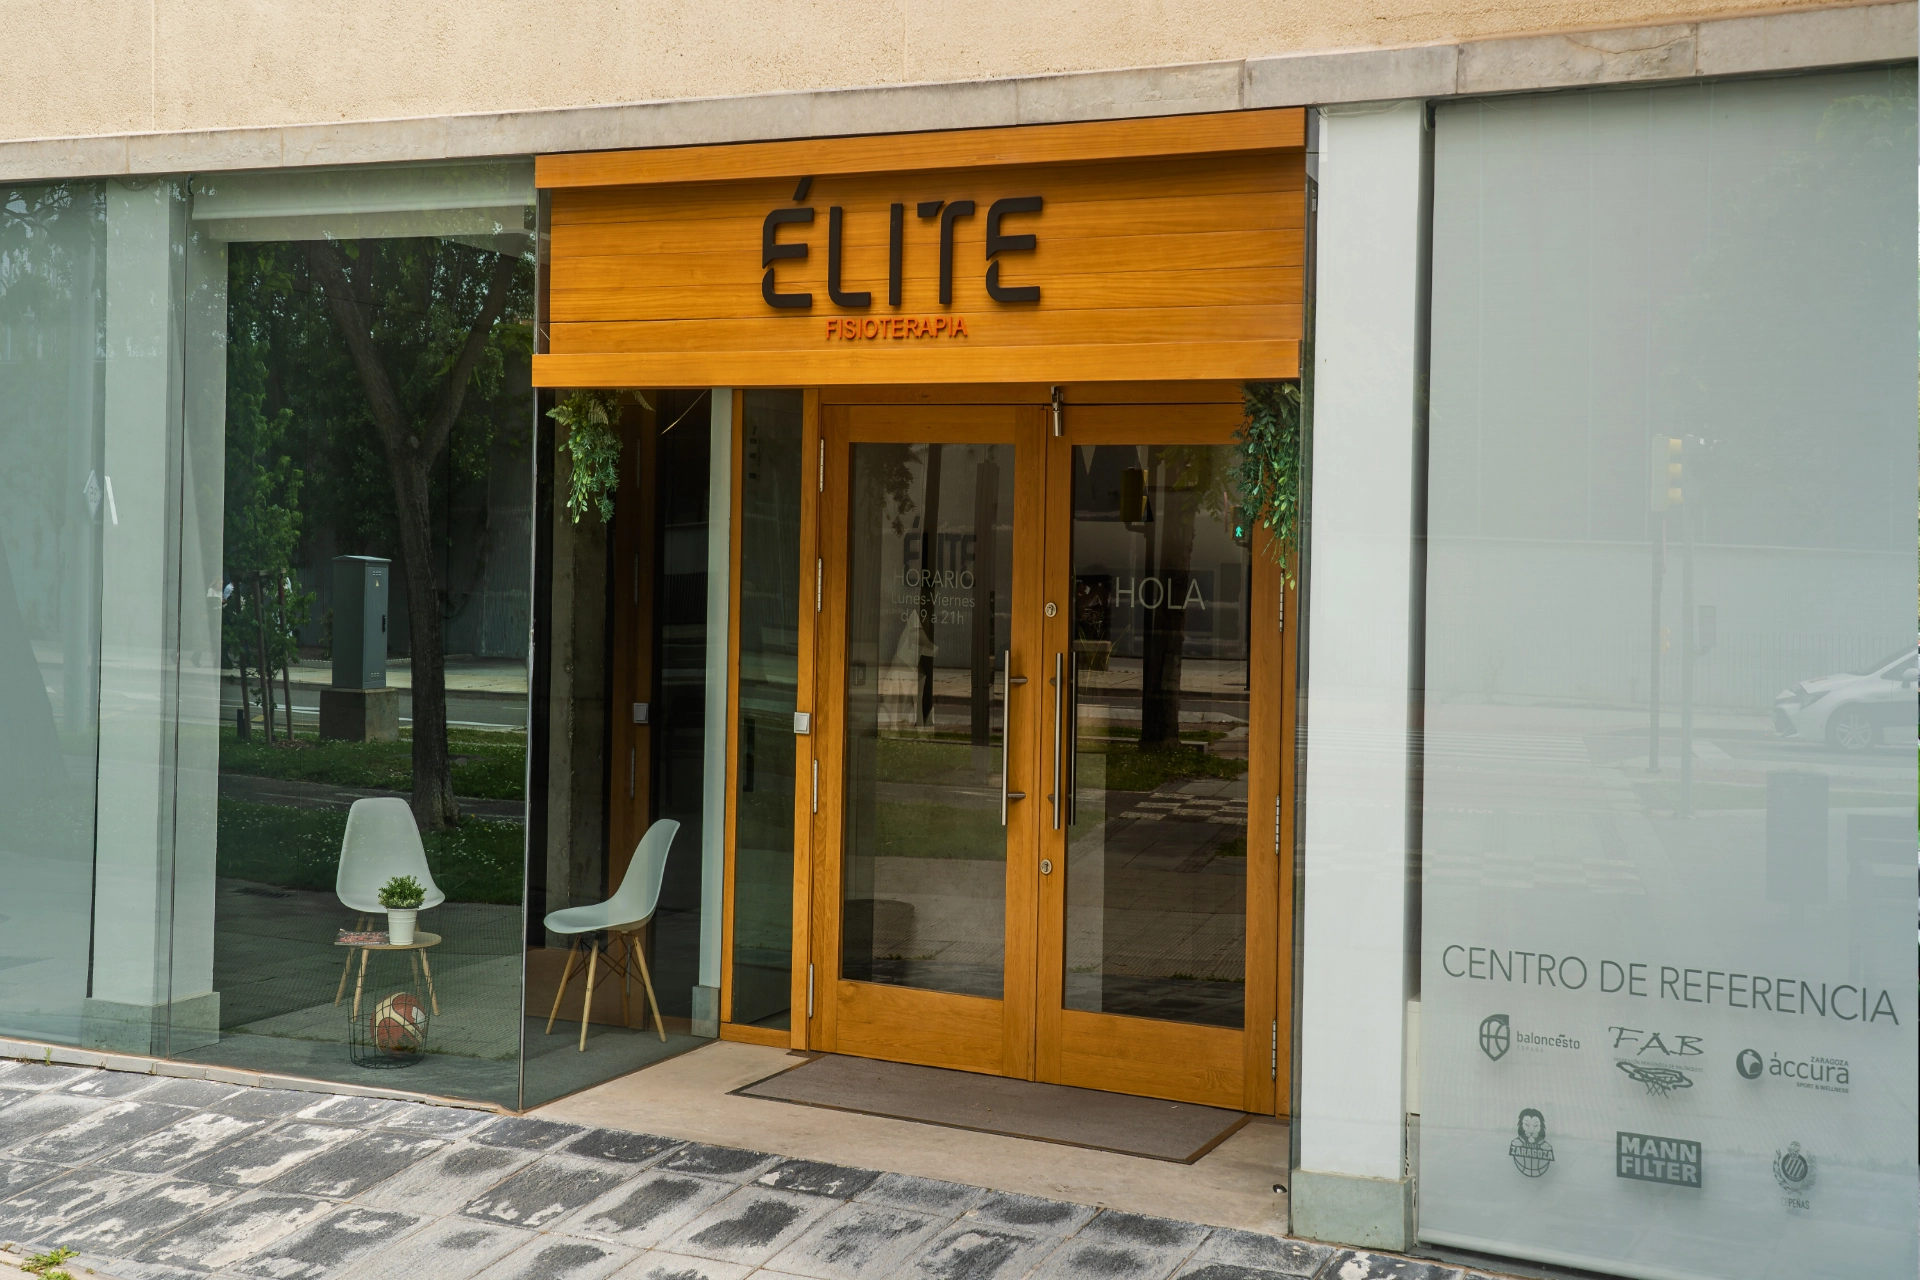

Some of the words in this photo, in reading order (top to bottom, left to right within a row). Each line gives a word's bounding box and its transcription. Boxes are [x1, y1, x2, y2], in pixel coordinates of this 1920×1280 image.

[762, 176, 1043, 308] ÉLITE
[826, 316, 968, 340] FISIOTERAPIA
[893, 568, 975, 590] HORARIO
[891, 591, 976, 608] Lunes-Viernes
[1115, 576, 1206, 611] HOLA
[920, 608, 928, 623] 9
[931, 613, 938, 623] a
[941, 610, 964, 625] 21h
[1442, 944, 1588, 990] CENTRO
[1600, 959, 1648, 997] DE
[1660, 966, 1900, 1026] REFERENCIA
[1608, 1026, 1704, 1056] FAB
[1810, 1056, 1850, 1068] ZARAGOZA
[1796, 1081, 1814, 1090] SPORT
[1820, 1084, 1850, 1094] WELLNESS
[1510, 1146, 1553, 1160] ZARAGOZA
[1621, 1135, 1698, 1163] MANN
[1621, 1155, 1698, 1183] FILTER
